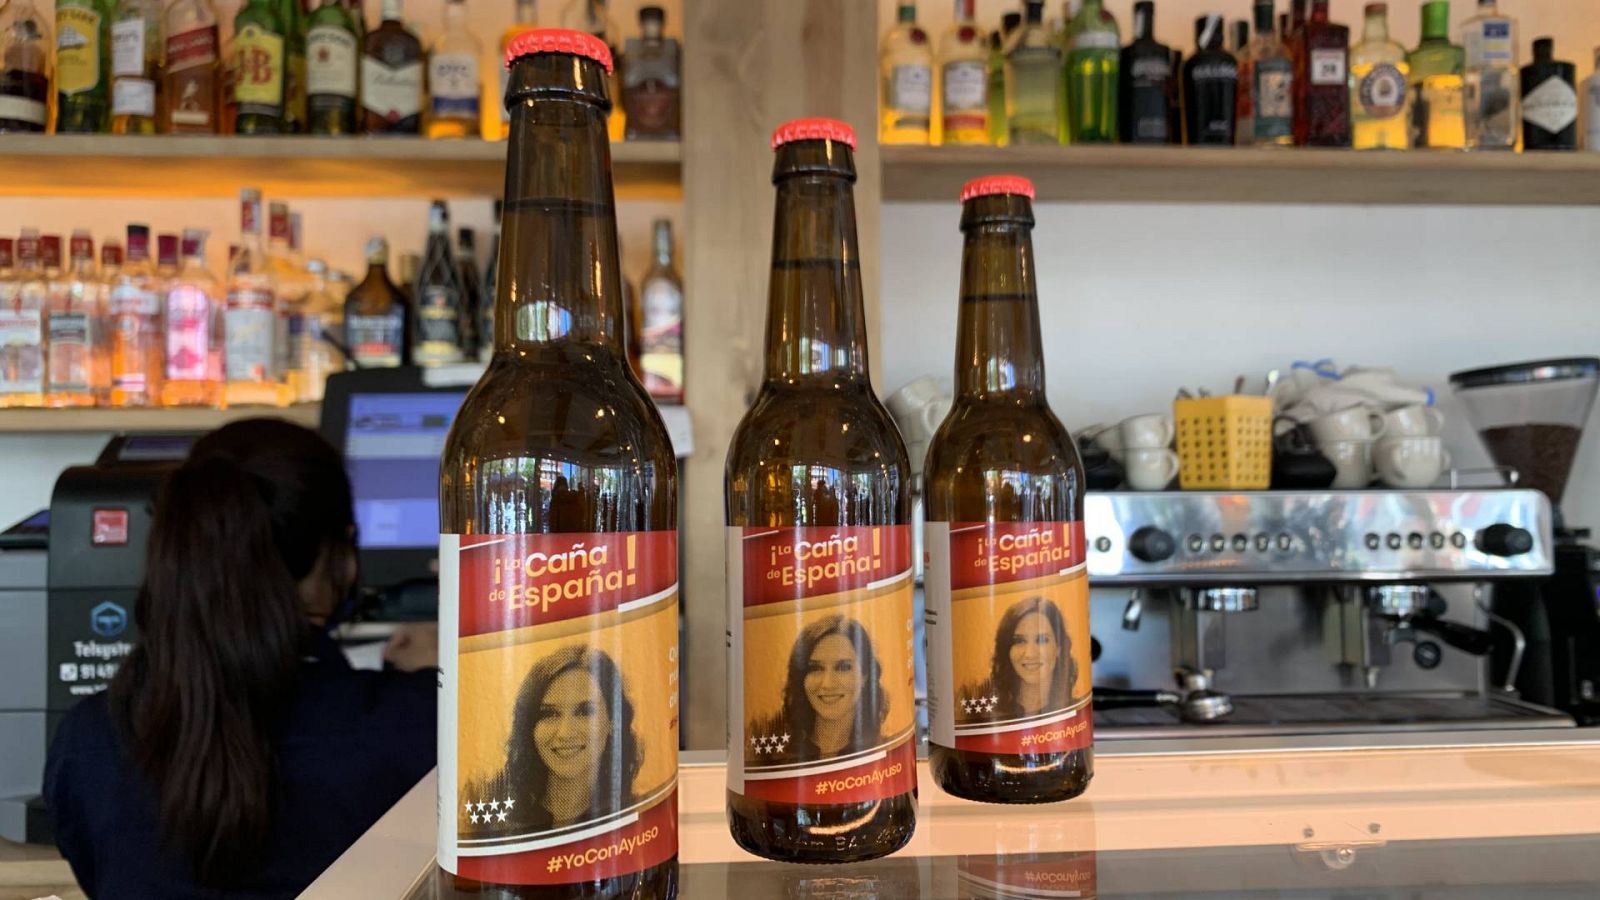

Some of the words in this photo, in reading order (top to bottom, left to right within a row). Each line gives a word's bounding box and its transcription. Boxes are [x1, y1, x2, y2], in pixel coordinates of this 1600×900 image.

[793, 534, 858, 561] Caña
[999, 528, 1053, 551] Caña
[525, 542, 608, 578] Caña
[974, 558, 987, 568] de
[767, 569, 780, 580] de
[488, 589, 506, 603] de
[1020, 719, 1088, 748] #YoConAyuso
[815, 762, 903, 796] #YoConAyuso
[545, 826, 660, 874] #YoConAyuso
